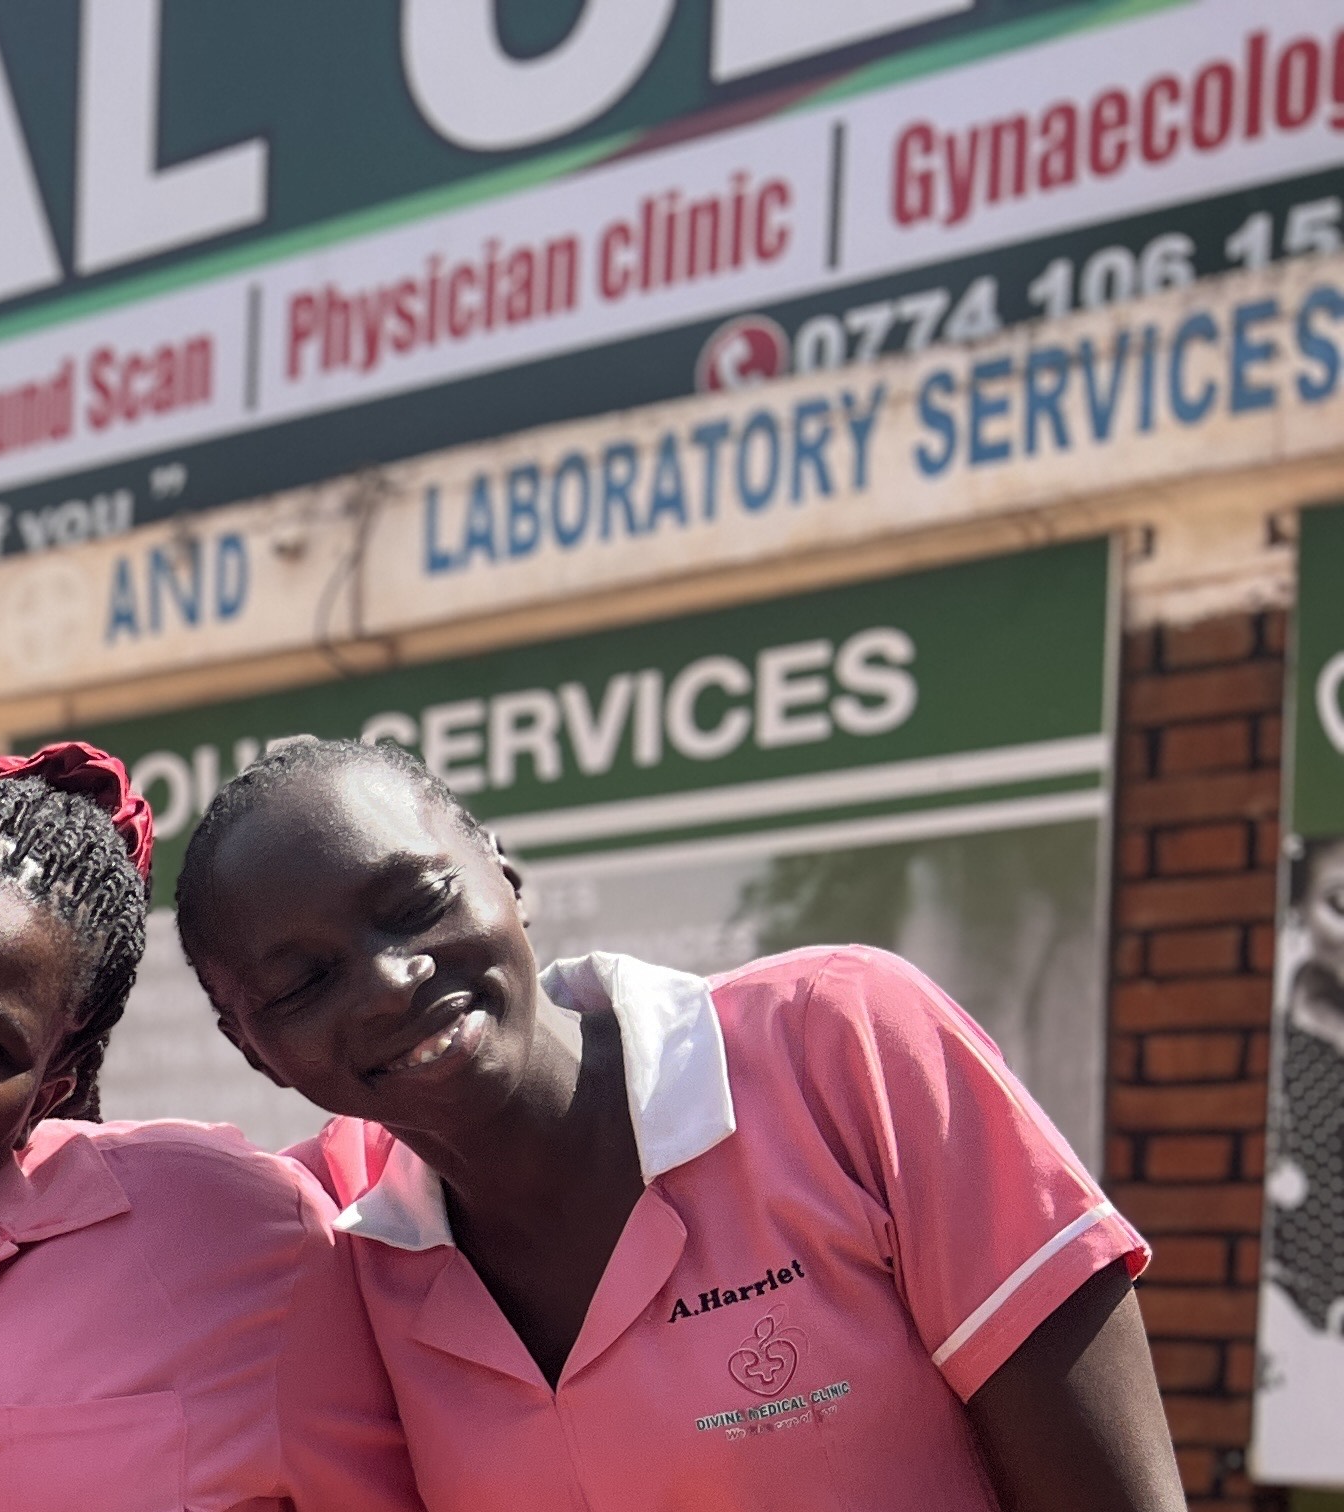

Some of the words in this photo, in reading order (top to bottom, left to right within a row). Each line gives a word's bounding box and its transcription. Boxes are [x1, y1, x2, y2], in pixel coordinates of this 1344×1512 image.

[890, 26, 1344, 232] Gynaecolo
[286, 232, 581, 381] Physician
[597, 168, 795, 300] clinic
[793, 275, 1004, 372] 0774
[86, 332, 215, 430] Scan
[105, 534, 250, 645] AND
[423, 379, 889, 577] LABORATORY
[913, 280, 1344, 478] SERVICES
[18, 489, 134, 554] you
[360, 626, 918, 798] ERVICES
[667, 1258, 806, 1324] A.Harriet
[695, 1410, 745, 1431] DIVINE
[748, 1395, 807, 1421] MEDICAL
[811, 1380, 850, 1404] CLINIC
